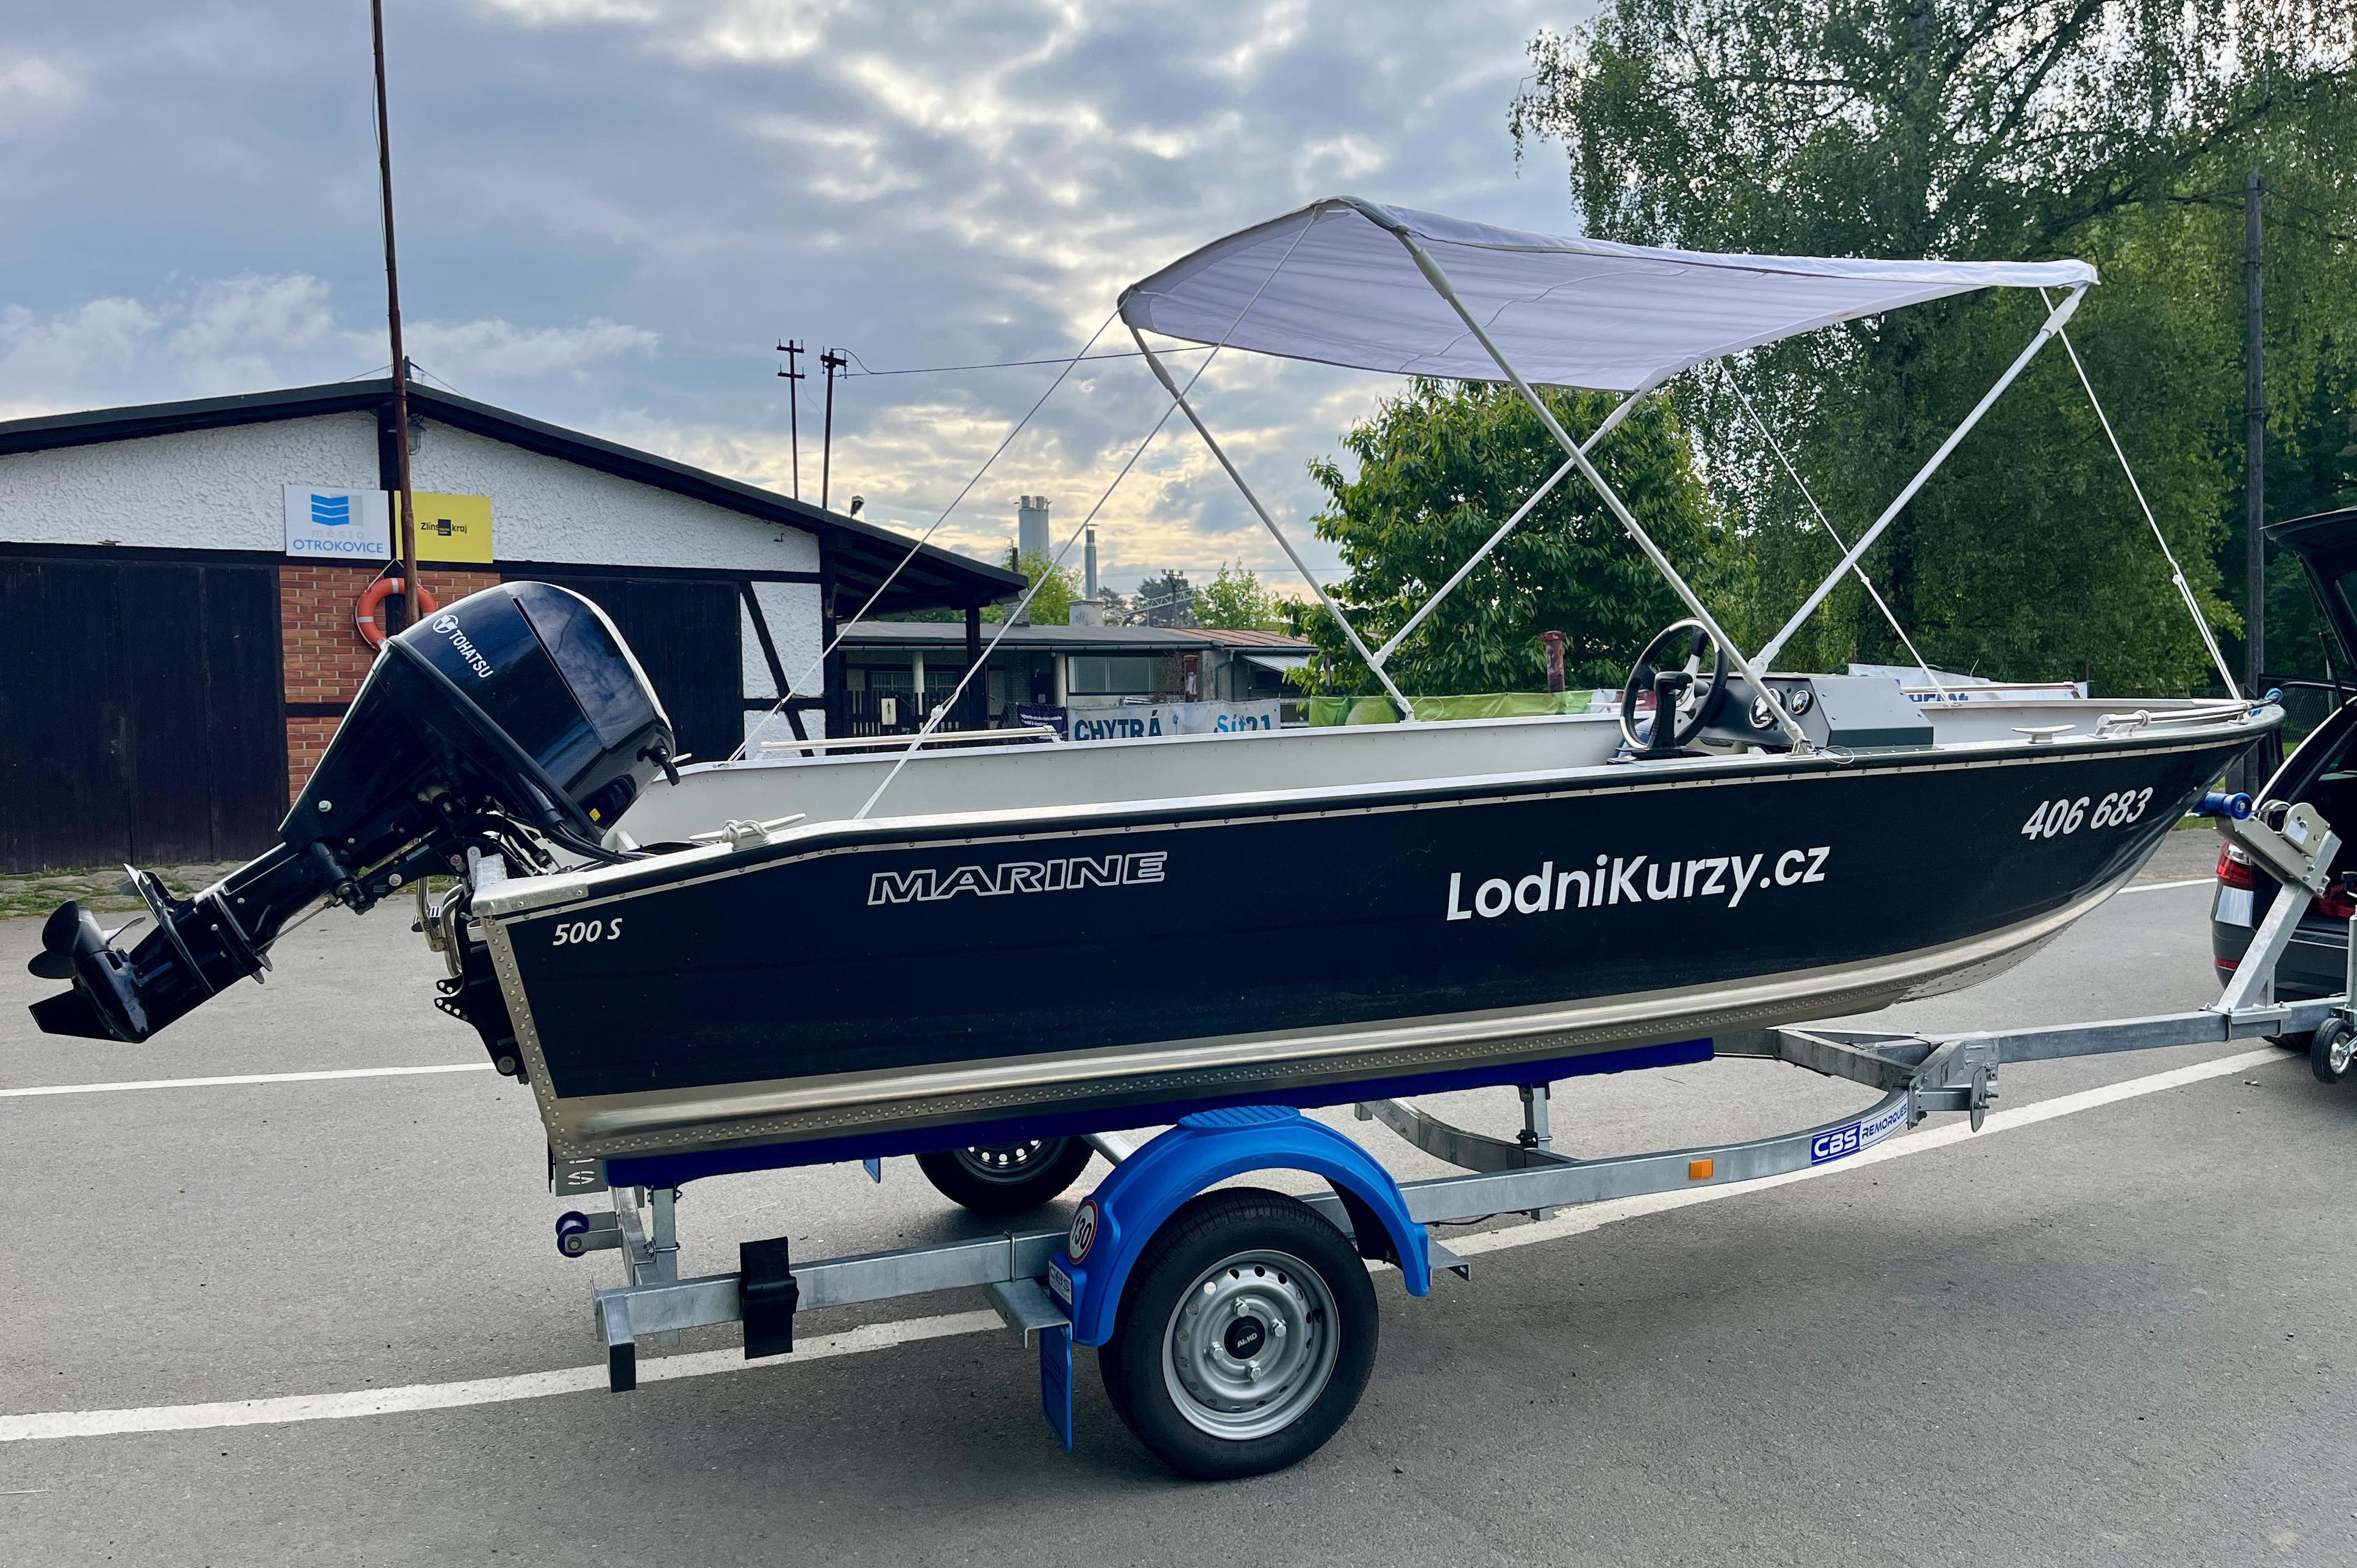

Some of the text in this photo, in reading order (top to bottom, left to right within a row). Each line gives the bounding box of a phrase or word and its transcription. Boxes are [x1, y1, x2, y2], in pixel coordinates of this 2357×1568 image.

[312, 529, 364, 539] město
[452, 524, 467, 534] kraj
[293, 539, 384, 553] OTROKOVICE
[449, 629, 493, 678] TOHATSU
[1074, 710, 1162, 741] CHYTRÁ
[2021, 787, 2153, 840] 406 683
[867, 851, 1167, 905] MARINE
[1447, 847, 1830, 921] LodniKurzy.cz
[553, 918, 623, 945] 500 S
[1814, 1103, 1907, 1157] CBS REMORQUES
[1071, 1214, 1092, 1250] 130
[1050, 1266, 1070, 1292] CBS
